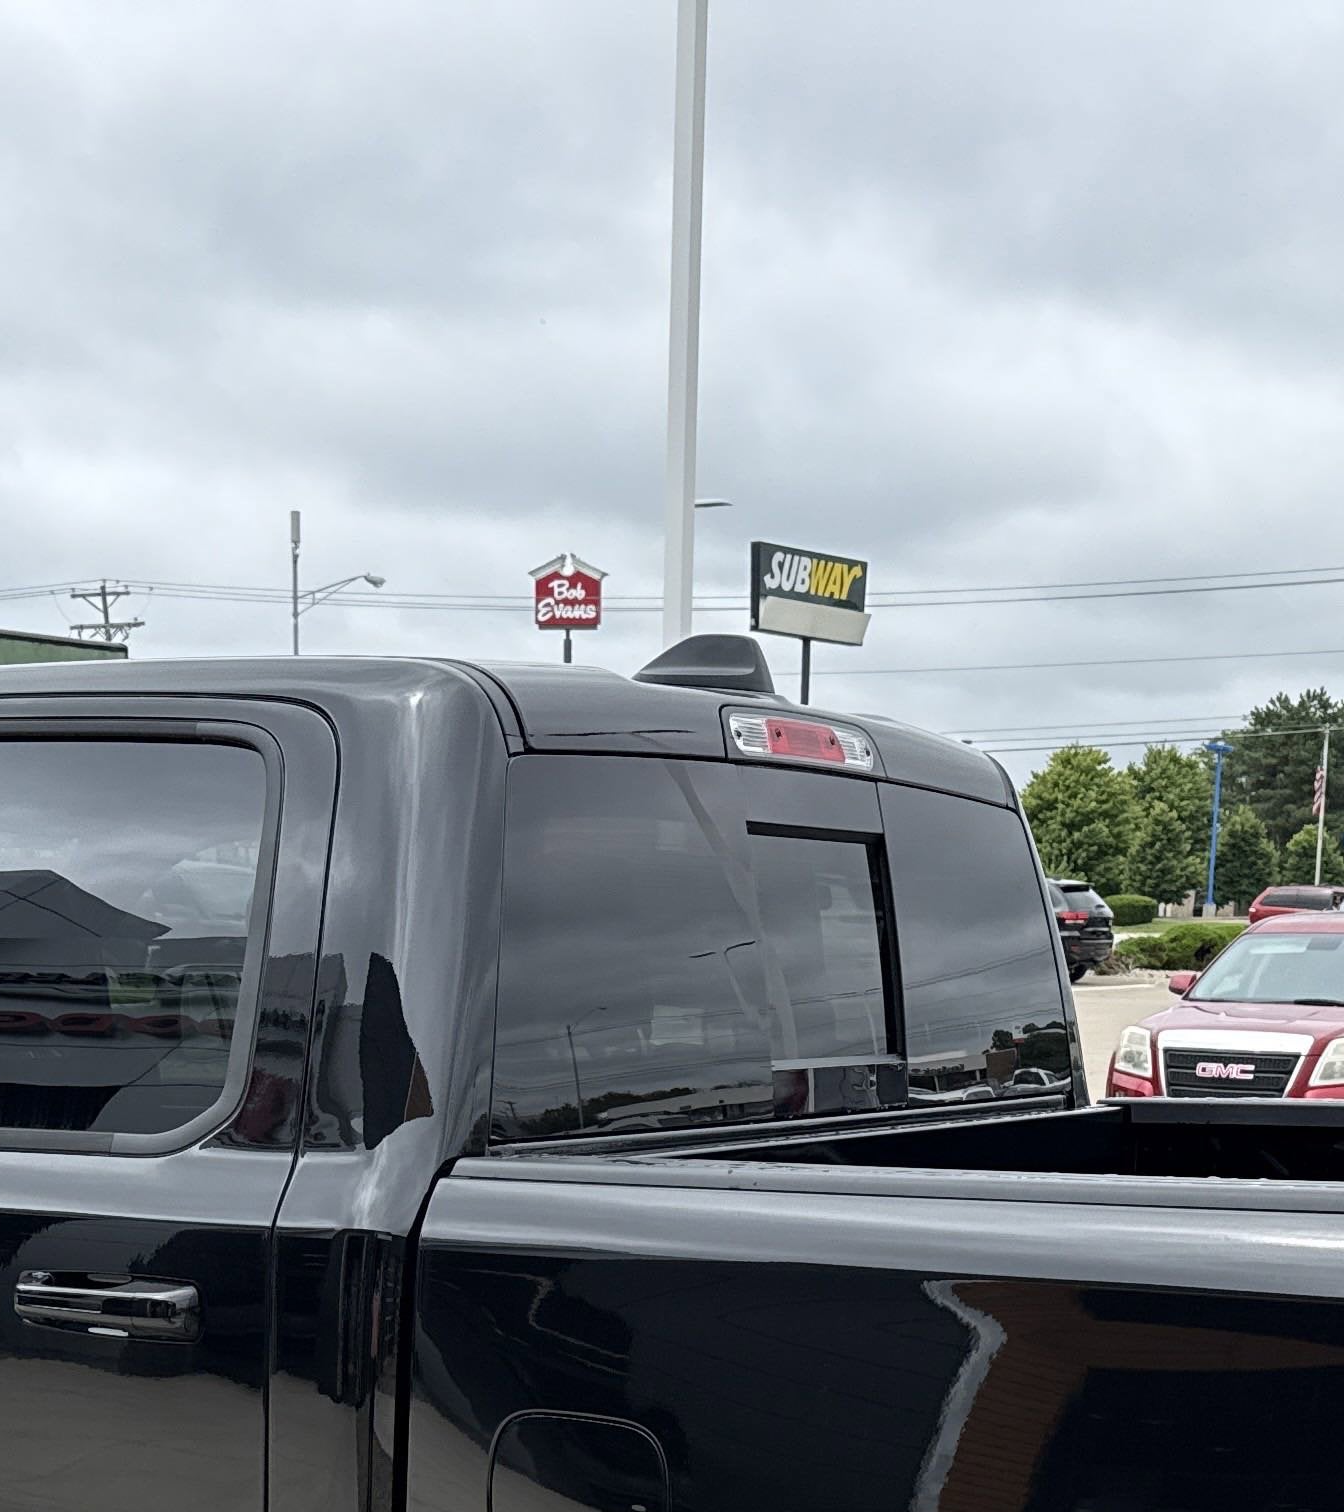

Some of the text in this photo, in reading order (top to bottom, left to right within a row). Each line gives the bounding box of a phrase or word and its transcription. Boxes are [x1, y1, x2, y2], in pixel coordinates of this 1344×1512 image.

[764, 551, 863, 600] SUBWAY
[547, 580, 586, 600] Bob
[537, 598, 597, 622] Evans
[1195, 1061, 1256, 1080] GMC
